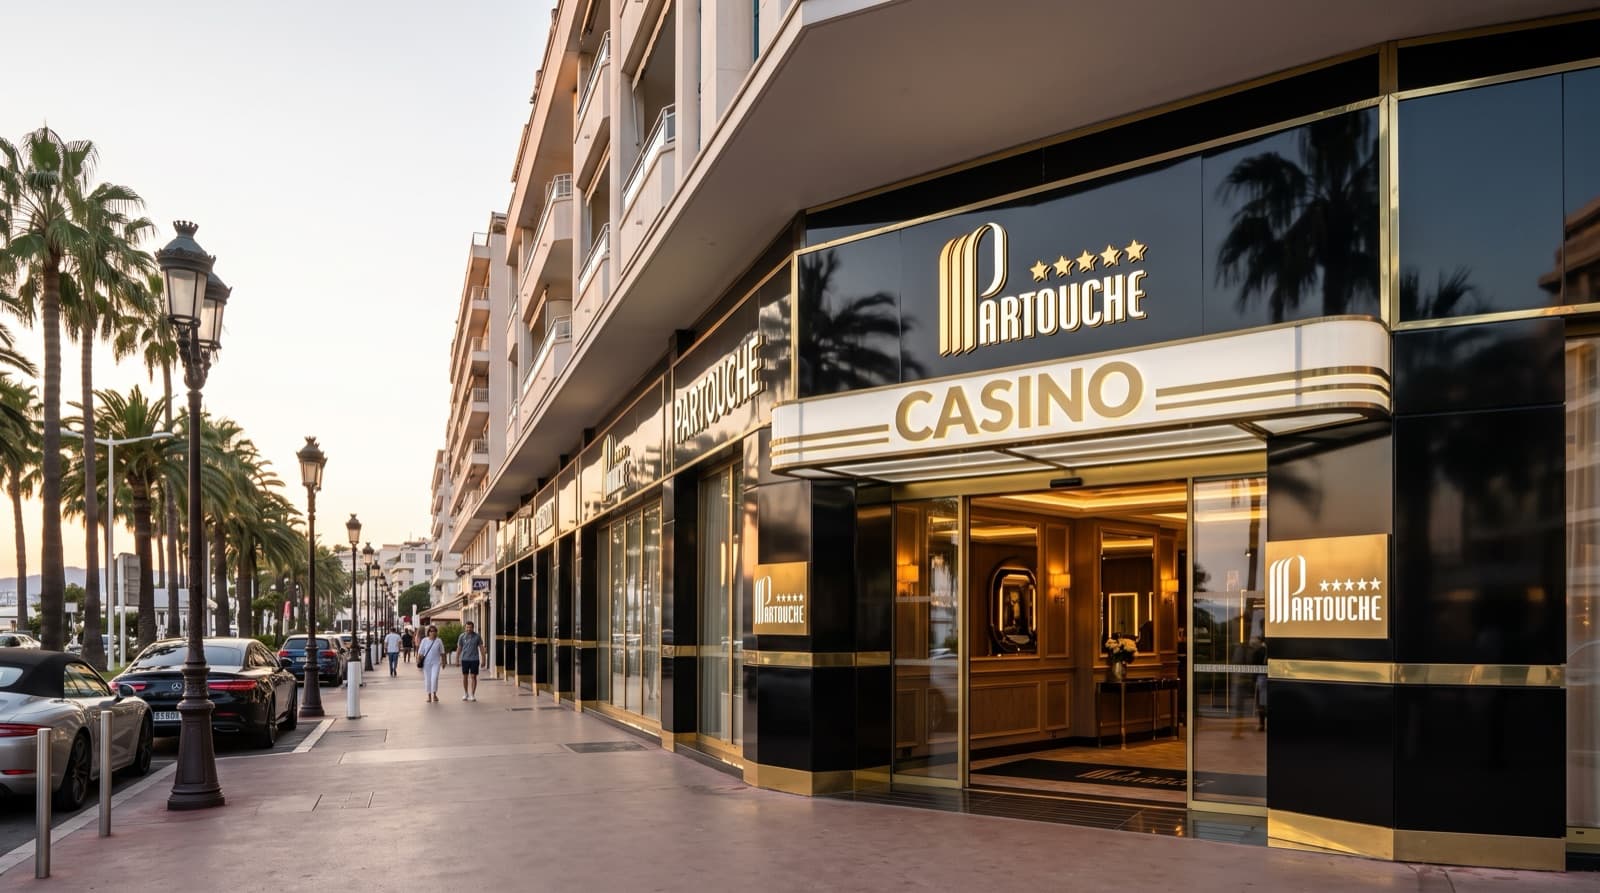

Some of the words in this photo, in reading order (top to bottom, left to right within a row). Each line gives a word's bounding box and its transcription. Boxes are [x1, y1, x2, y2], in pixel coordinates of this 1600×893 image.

[939, 222, 1148, 357] PARTOUCHE
[675, 335, 766, 444] PARTOUCHE
[895, 361, 1144, 442] CASINO
[755, 575, 805, 625] PARTOUCHE
[1269, 554, 1382, 624] PARTOUCHE
